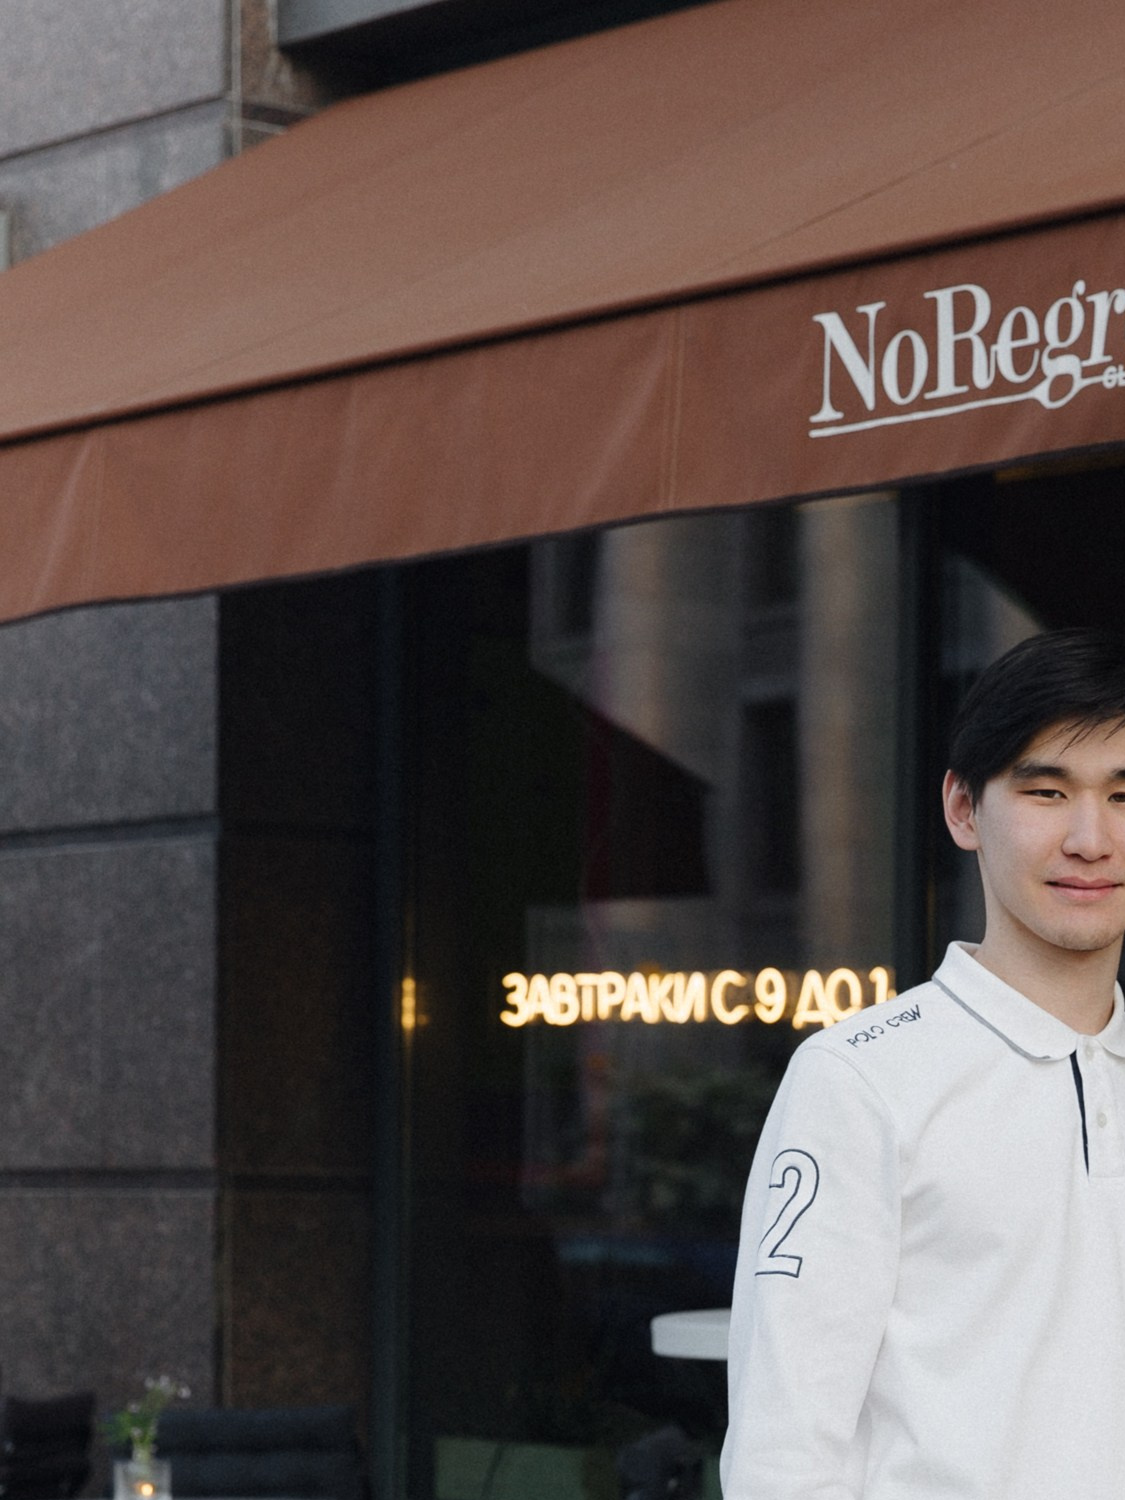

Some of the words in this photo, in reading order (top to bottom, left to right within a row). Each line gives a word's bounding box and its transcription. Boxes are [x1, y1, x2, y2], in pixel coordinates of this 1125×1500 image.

[500, 970, 706, 1027] ЗАВТРАКИ
[711, 969, 748, 1025] С
[754, 966, 787, 1024] 9
[792, 967, 863, 1030] ДО
[846, 1025, 885, 1048] POLO
[886, 1004, 922, 1028] CREW
[755, 1148, 820, 1278] 2
